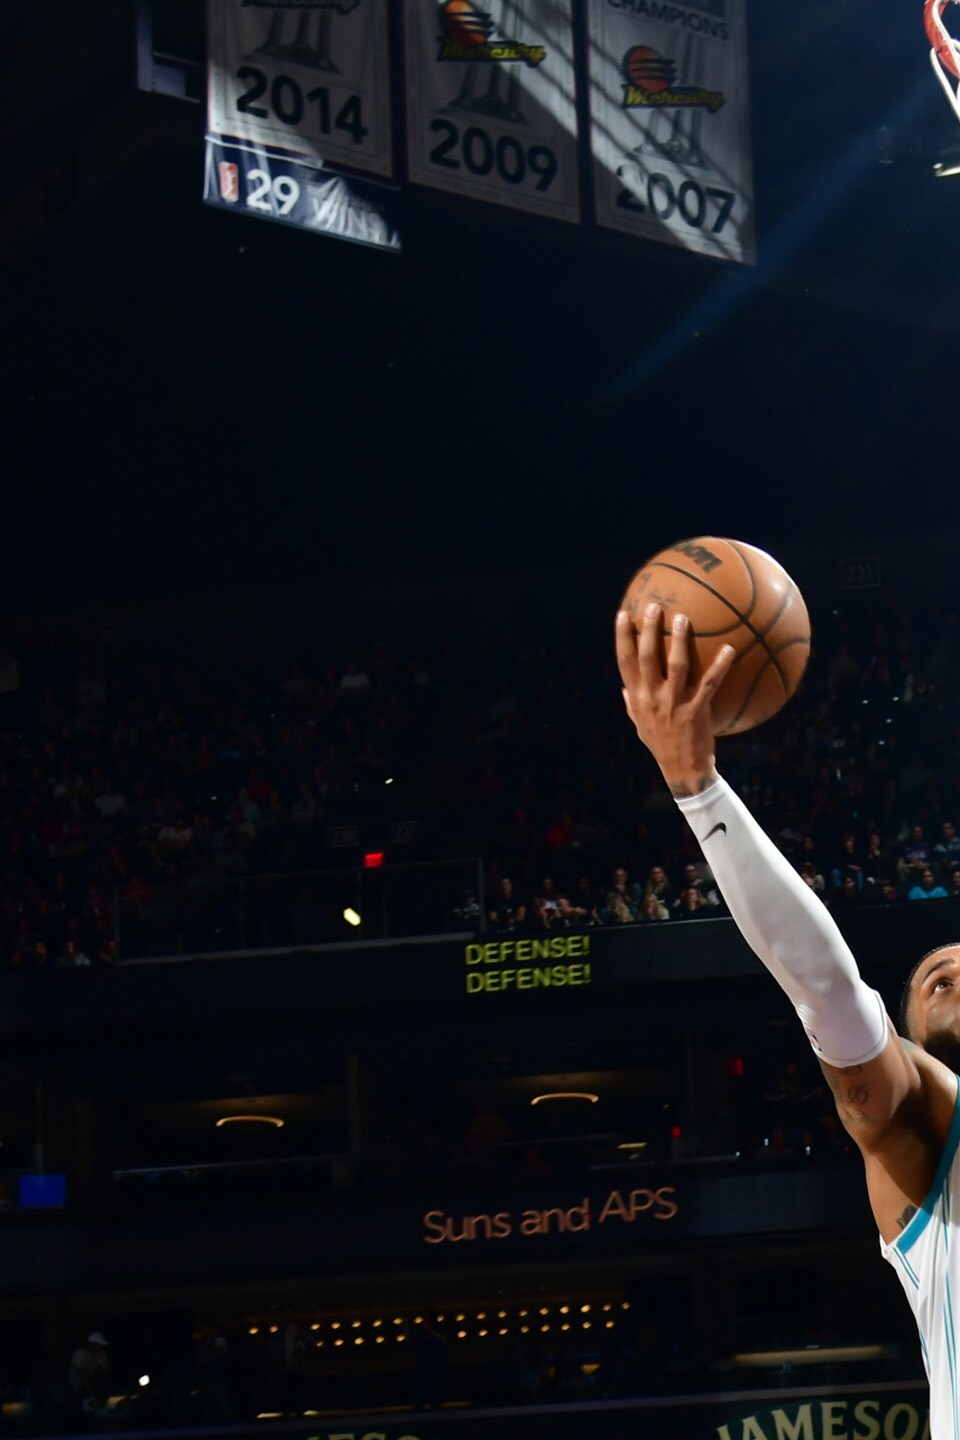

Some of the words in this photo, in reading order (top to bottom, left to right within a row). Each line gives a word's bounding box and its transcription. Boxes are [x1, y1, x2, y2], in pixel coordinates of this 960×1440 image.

[236, 66, 368, 144] 2014
[429, 118, 559, 192] 2009
[246, 168, 300, 216] 29
[616, 164, 736, 233] 2007
[465, 935, 590, 965] DEFENSE!
[466, 963, 591, 993] DEFENSE!
[423, 1210, 512, 1244] Suns
[520, 1197, 592, 1236] and
[598, 1186, 678, 1223] APS
